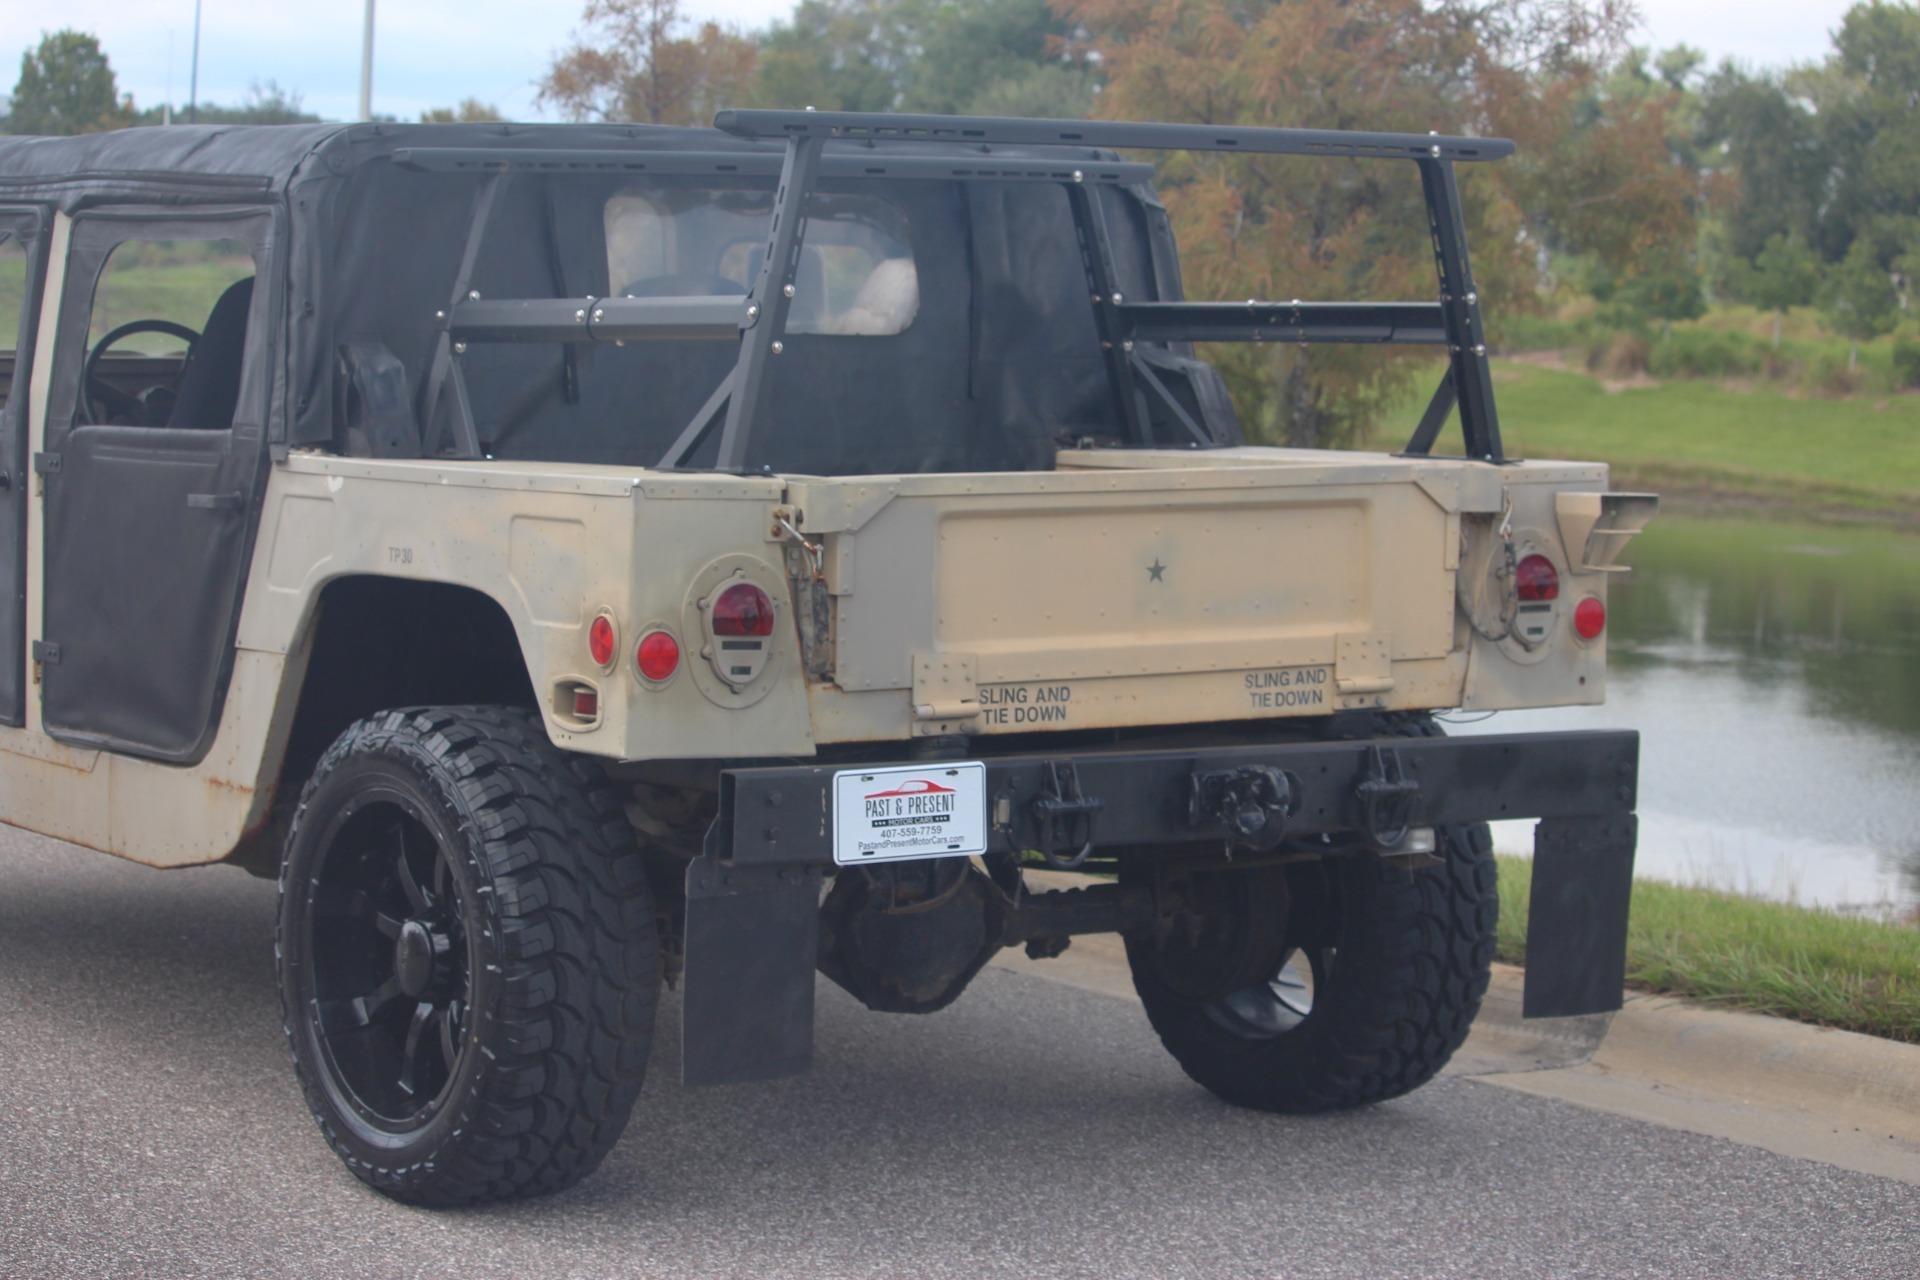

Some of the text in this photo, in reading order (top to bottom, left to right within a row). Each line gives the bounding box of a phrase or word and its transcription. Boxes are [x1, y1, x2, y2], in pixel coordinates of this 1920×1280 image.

[1245, 668, 1327, 688] SLING AND
[980, 686, 1071, 704] SLING AND
[1250, 689, 1323, 708] TIE DOWN
[983, 705, 1066, 724] TIE DOWN
[866, 794, 955, 818] PAST & PRESENT
[914, 816, 934, 824] CARS
[880, 826, 942, 838] 407-559-7759
[858, 836, 964, 850] PastandPresentMotorCars.com
